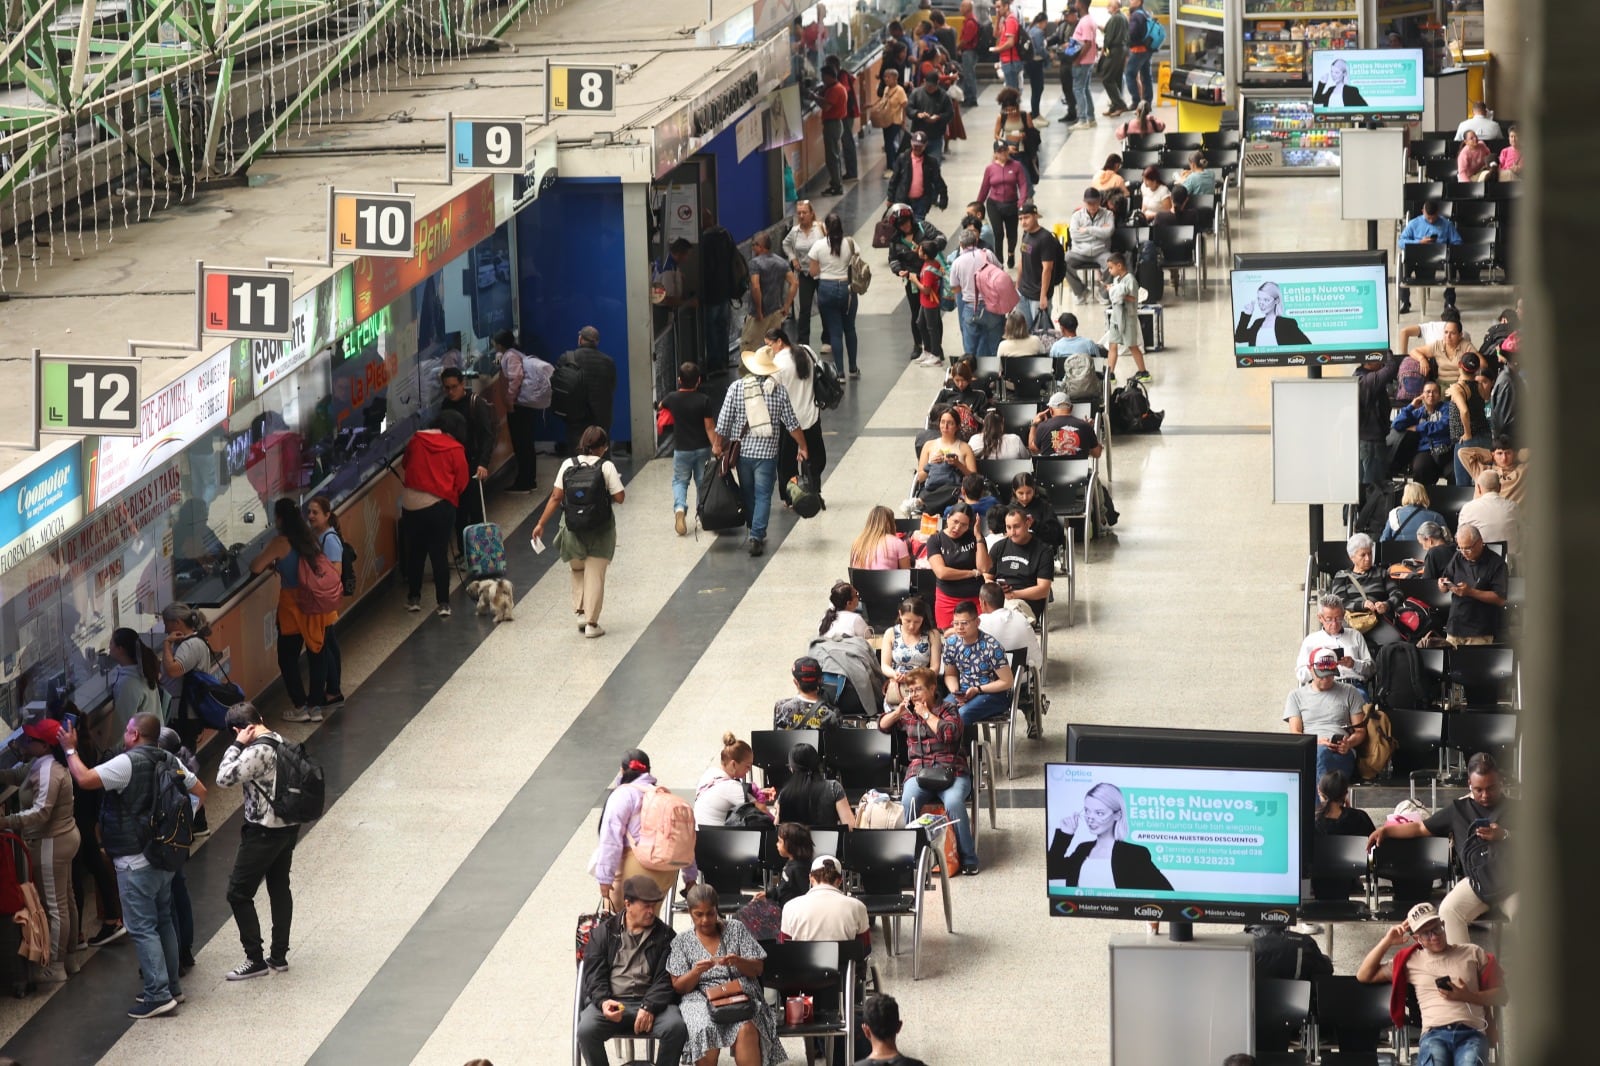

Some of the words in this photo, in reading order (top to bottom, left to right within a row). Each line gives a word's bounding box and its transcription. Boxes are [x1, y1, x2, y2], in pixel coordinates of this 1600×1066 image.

[579, 72, 603, 108] 8
[485, 126, 511, 164] 9
[360, 206, 404, 246] 10
[1284, 286, 1316, 294] Lentes
[1284, 294, 1310, 302] Estilo
[1312, 294, 1345, 302] Nuevo
[232, 282, 276, 326] 11
[74, 372, 130, 420] 12
[18, 464, 70, 514] Coomotor
[159, 464, 180, 496] TAXIS
[0, 536, 36, 574] FLORENCIA
[40, 514, 65, 544] MOCOA
[1130, 793, 1185, 808] Lentes
[1188, 795, 1258, 812] Nuevos,
[1130, 806, 1175, 820] Estilo
[1179, 808, 1234, 822] Nuevo
[1195, 822, 1207, 830] fue
[1157, 856, 1174, 864] +57
[1176, 856, 1192, 864] 310
[1134, 907, 1163, 918] Kalley
[1261, 912, 1290, 923] Kalley
